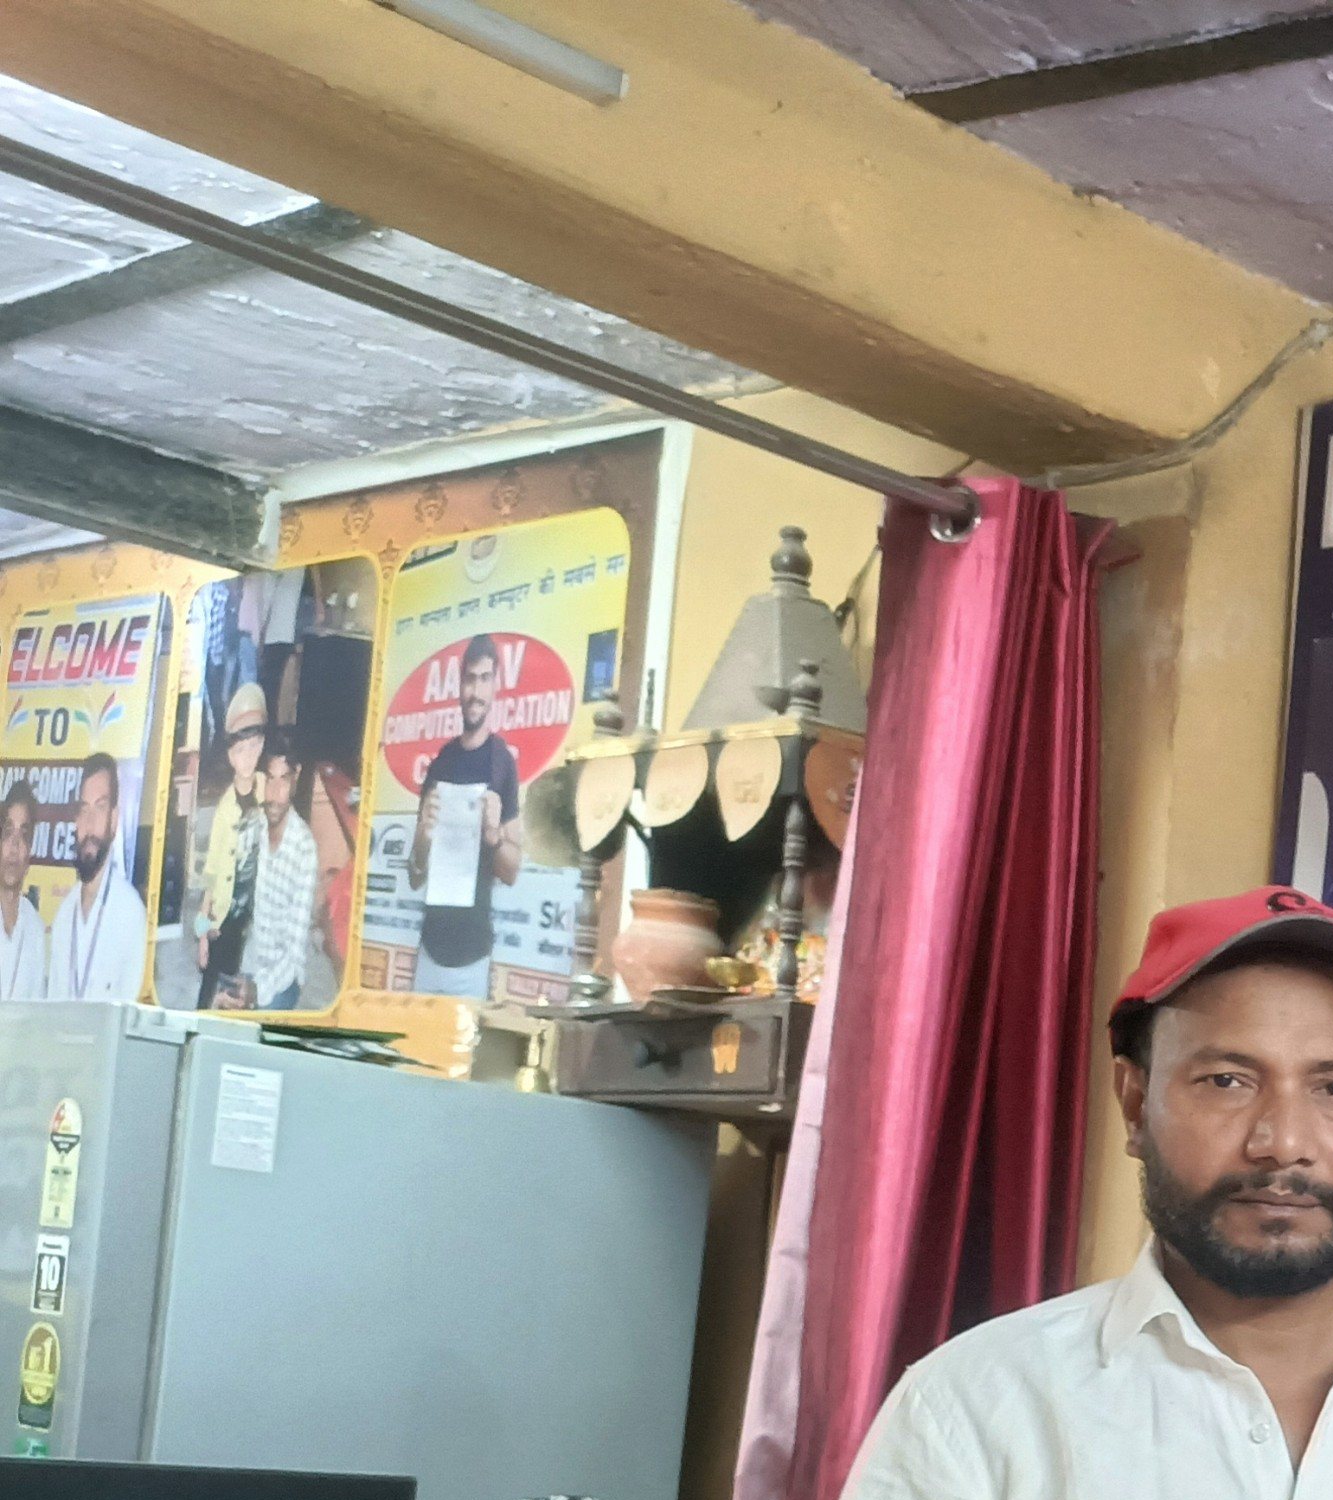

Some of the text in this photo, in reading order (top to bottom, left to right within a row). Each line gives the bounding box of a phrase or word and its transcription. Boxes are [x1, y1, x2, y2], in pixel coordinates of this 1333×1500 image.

[7, 615, 150, 683] ELCOME
[423, 641, 528, 704] AAV
[35, 707, 71, 747] TO
[490, 690, 573, 733] UCATION
[29, 765, 85, 805] COMP
